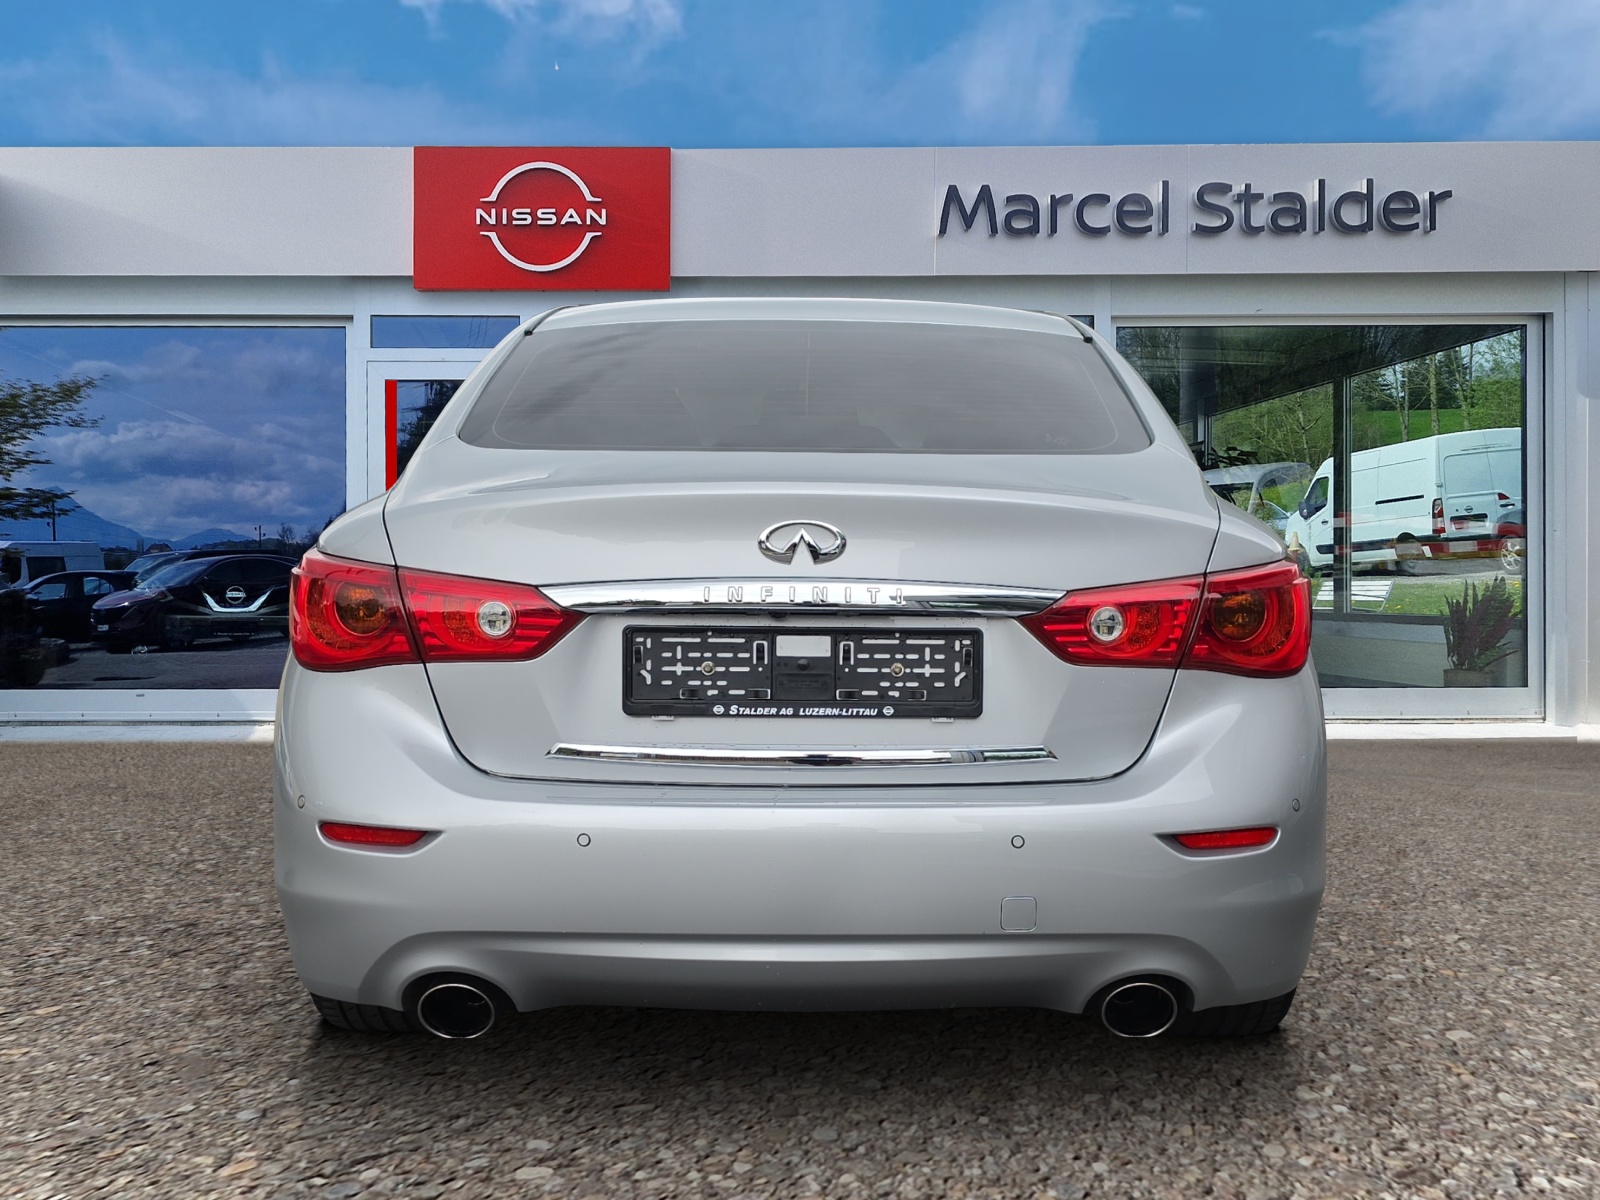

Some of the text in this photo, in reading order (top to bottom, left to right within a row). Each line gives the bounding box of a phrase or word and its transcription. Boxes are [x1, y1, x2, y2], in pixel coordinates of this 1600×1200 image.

[475, 208, 607, 226] NISSAN
[936, 178, 1453, 238] Marcel Stalder
[703, 586, 904, 605] INFINITI
[729, 705, 878, 716] STALDER AG LUZERN-LITTAU
